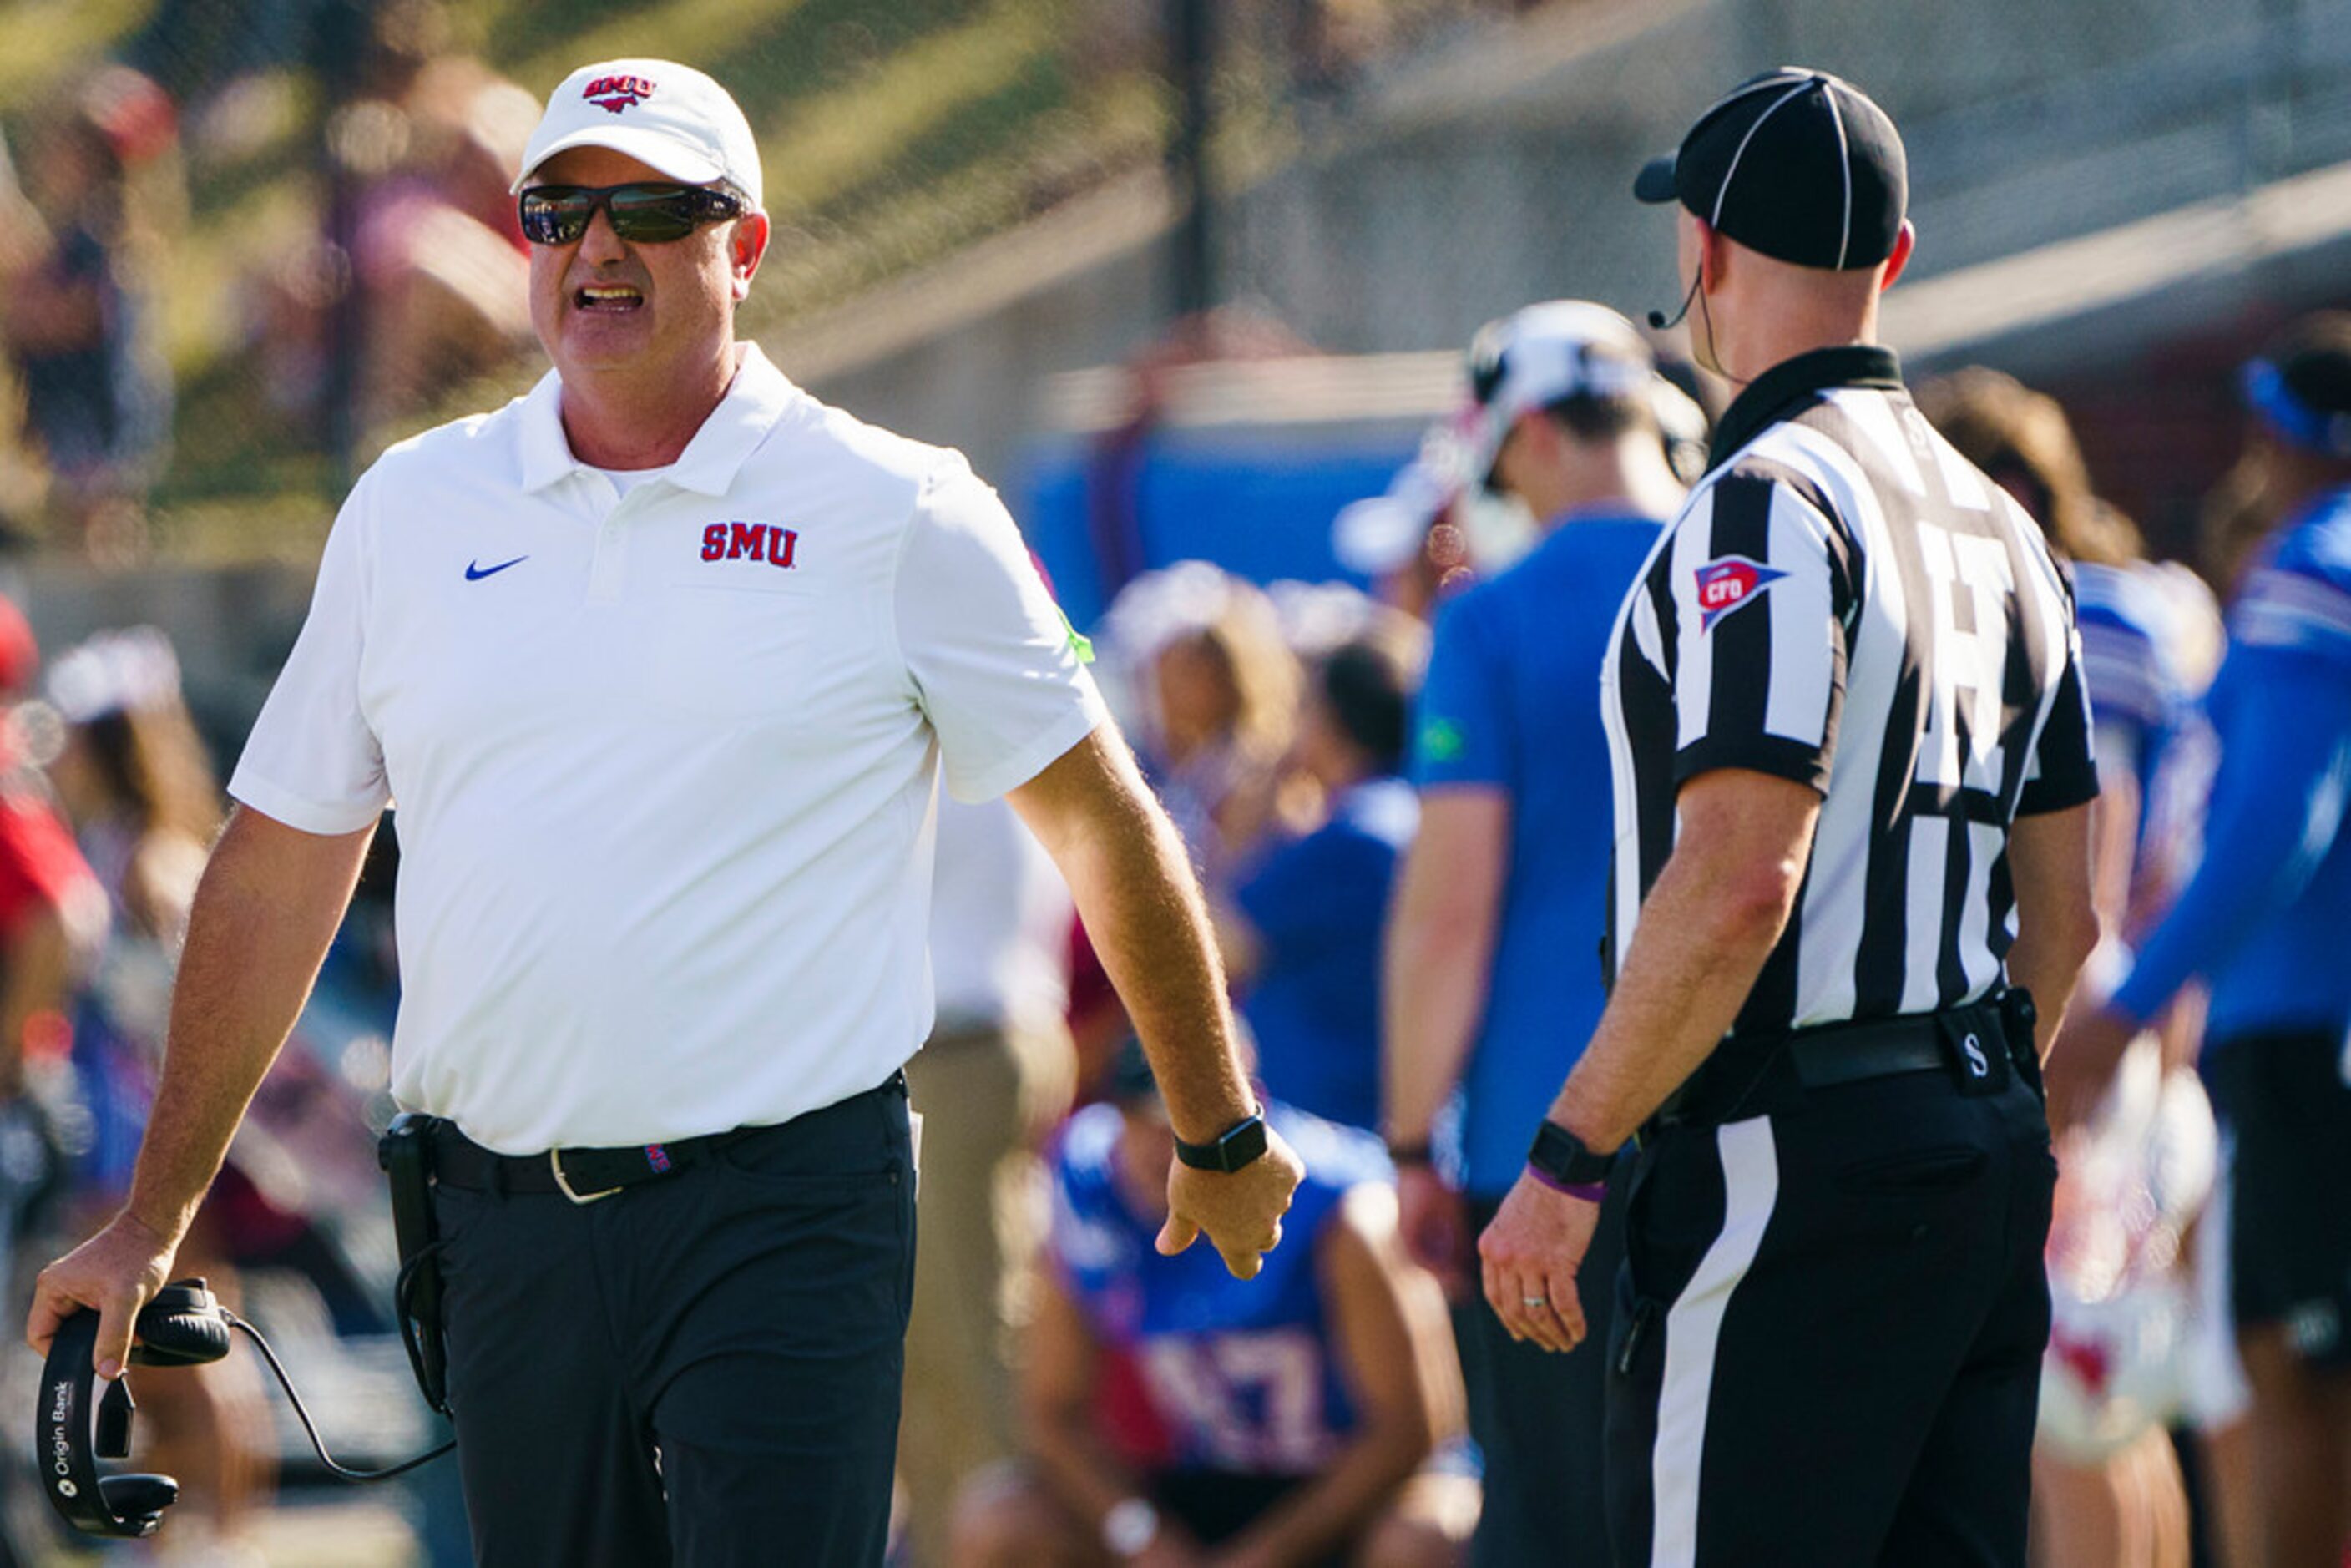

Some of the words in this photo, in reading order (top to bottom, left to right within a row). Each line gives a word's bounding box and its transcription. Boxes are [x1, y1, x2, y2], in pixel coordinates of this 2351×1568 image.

[582, 74, 654, 99] SMU
[700, 521, 798, 569] SMU
[1706, 579, 1742, 604] CFO
[52, 1381, 68, 1422] Bank
[52, 1425, 70, 1476] Origin
